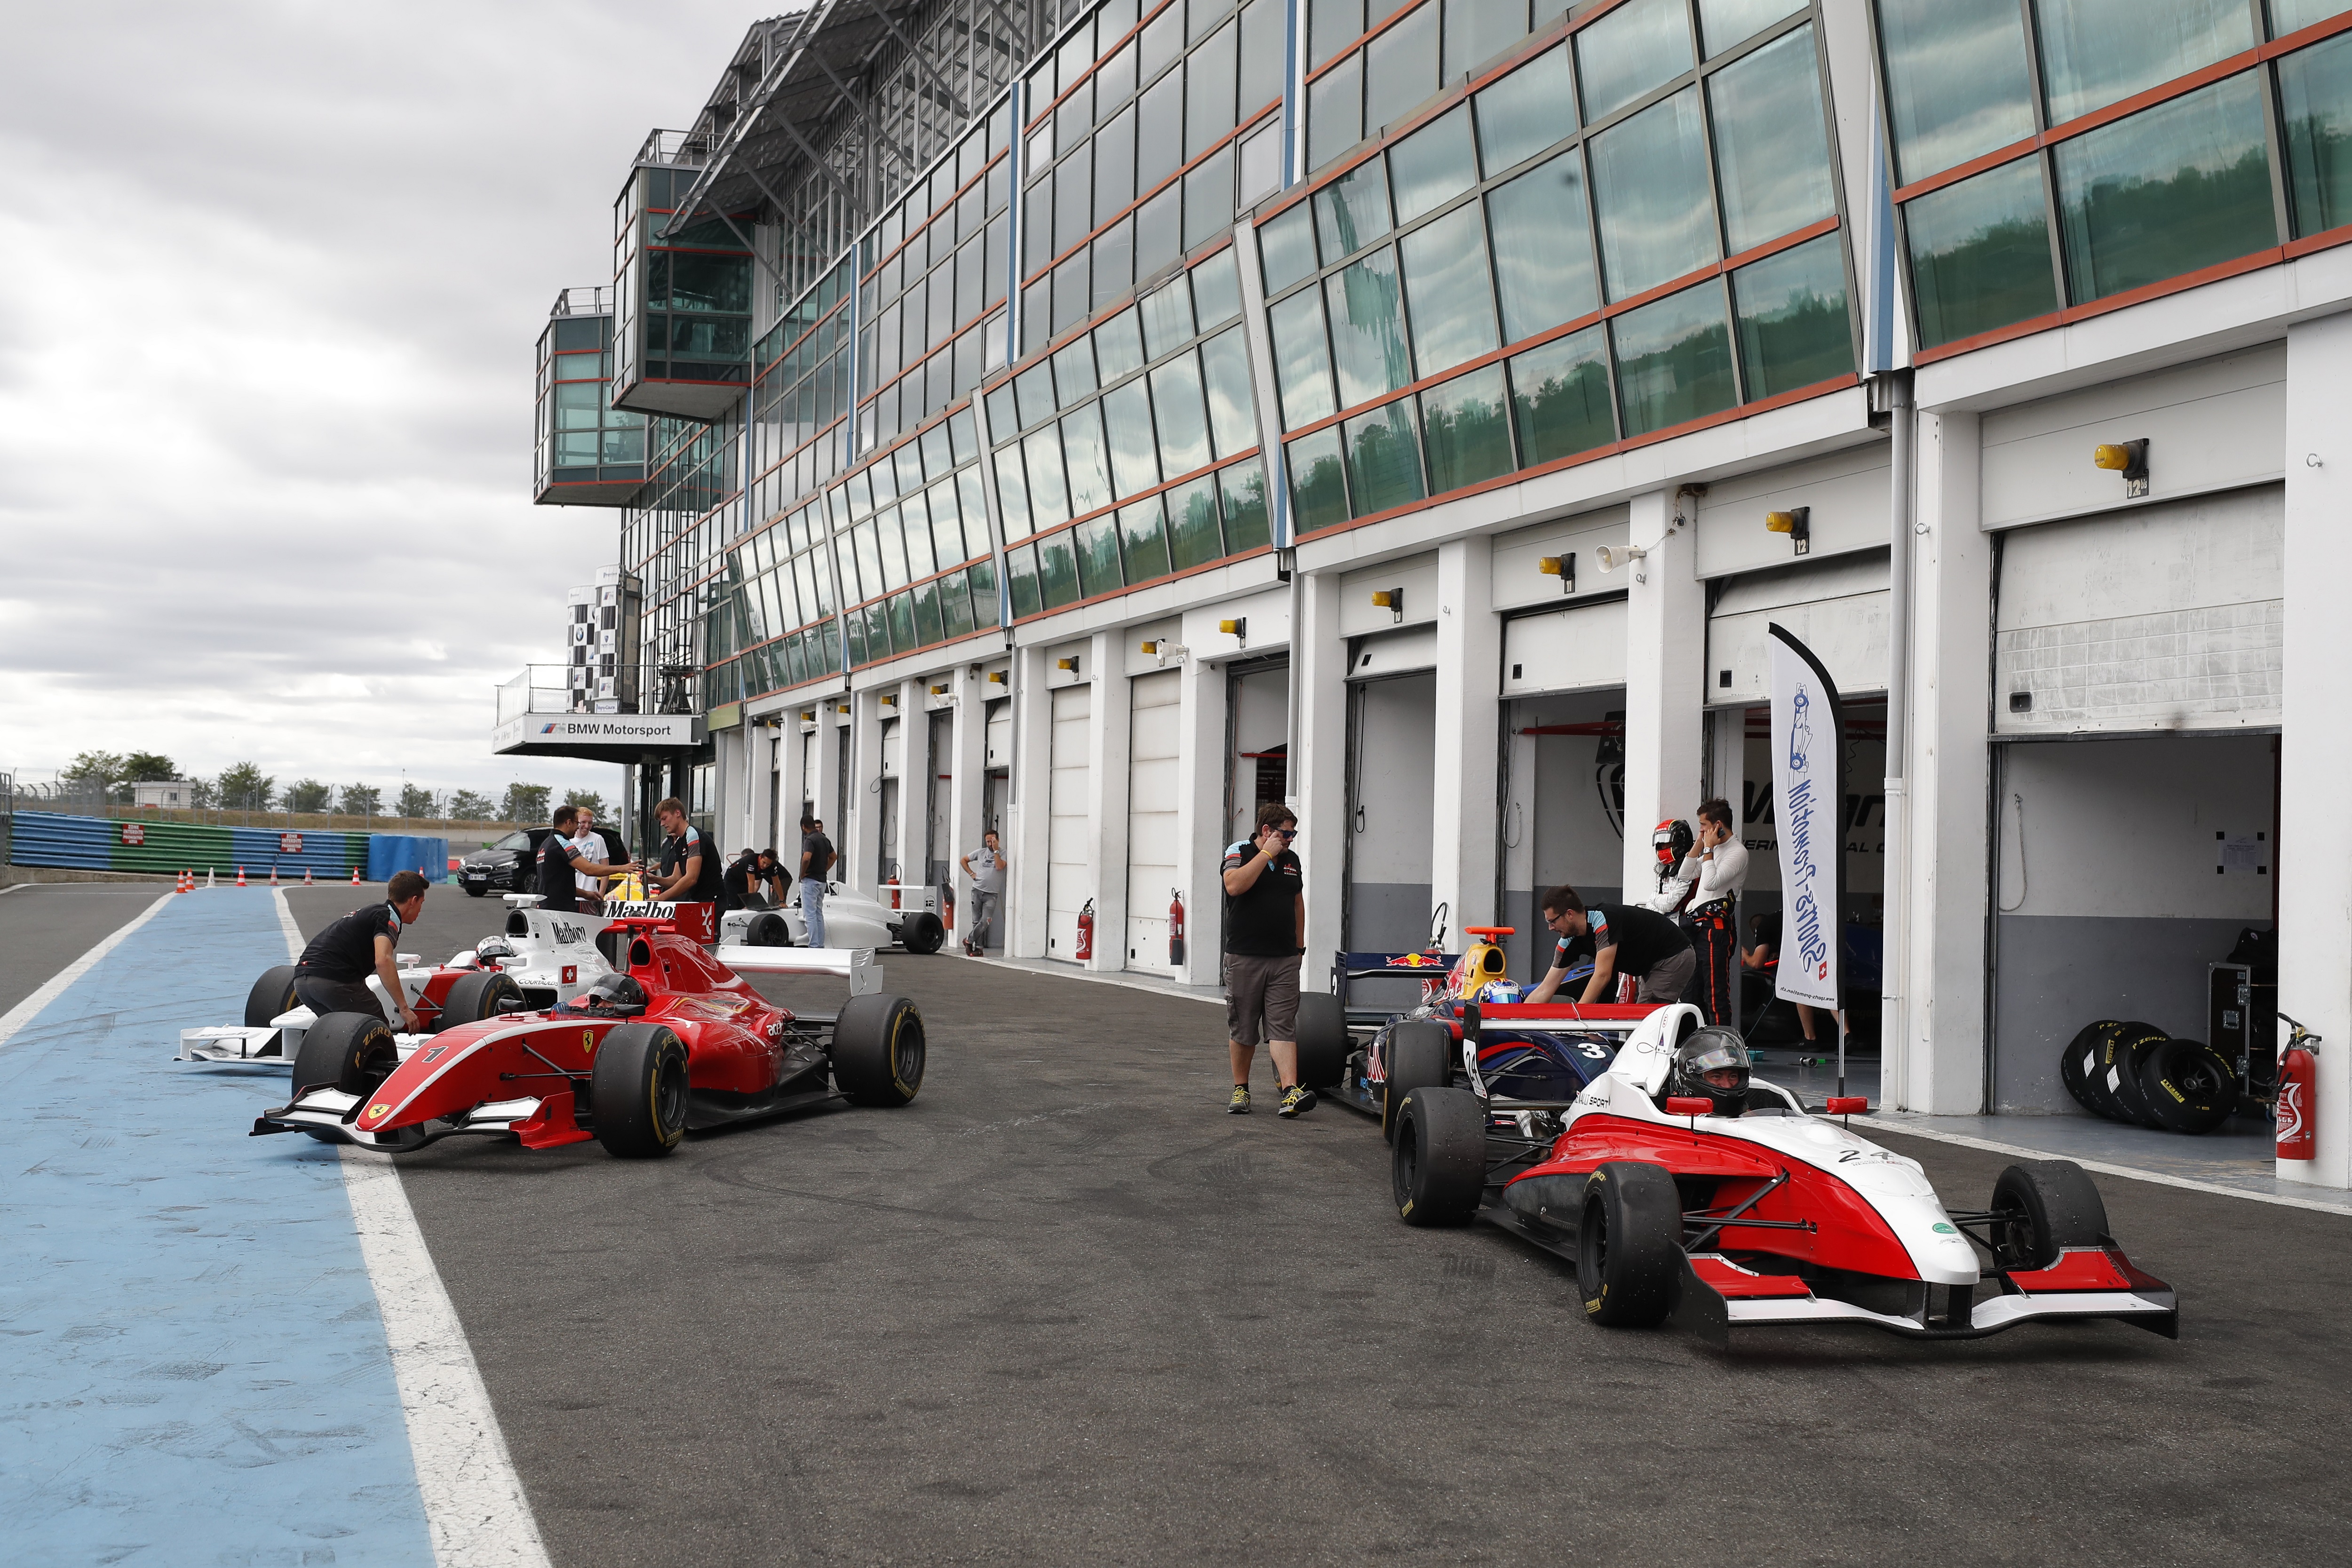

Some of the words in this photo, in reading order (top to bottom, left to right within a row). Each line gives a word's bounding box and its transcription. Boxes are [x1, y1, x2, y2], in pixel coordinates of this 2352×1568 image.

[2128, 479, 2141, 497] 12
[1797, 539, 1806, 554] 12
[1566, 580, 1572, 592] 11
[1395, 611, 1401, 622] 10
[568, 724, 600, 734] BMW
[603, 724, 671, 737] Motorsport
[606, 901, 676, 917] Marlbo
[552, 922, 587, 944] Marlboro
[355, 1051, 360, 1068] P
[363, 1027, 391, 1046] ZERO
[2138, 1036, 2166, 1045] ZERO
[422, 1046, 449, 1063] 1
[655, 1051, 660, 1068] P
[1578, 1043, 1606, 1059] 3
[2105, 1039, 2115, 1065] PIRELLI
[2161, 1079, 2185, 1103] PIRELLI
[1574, 1092, 1590, 1105] ENAULT
[1589, 1096, 1609, 1109] SPORT
[1585, 1297, 1602, 1314] PIRELLI
